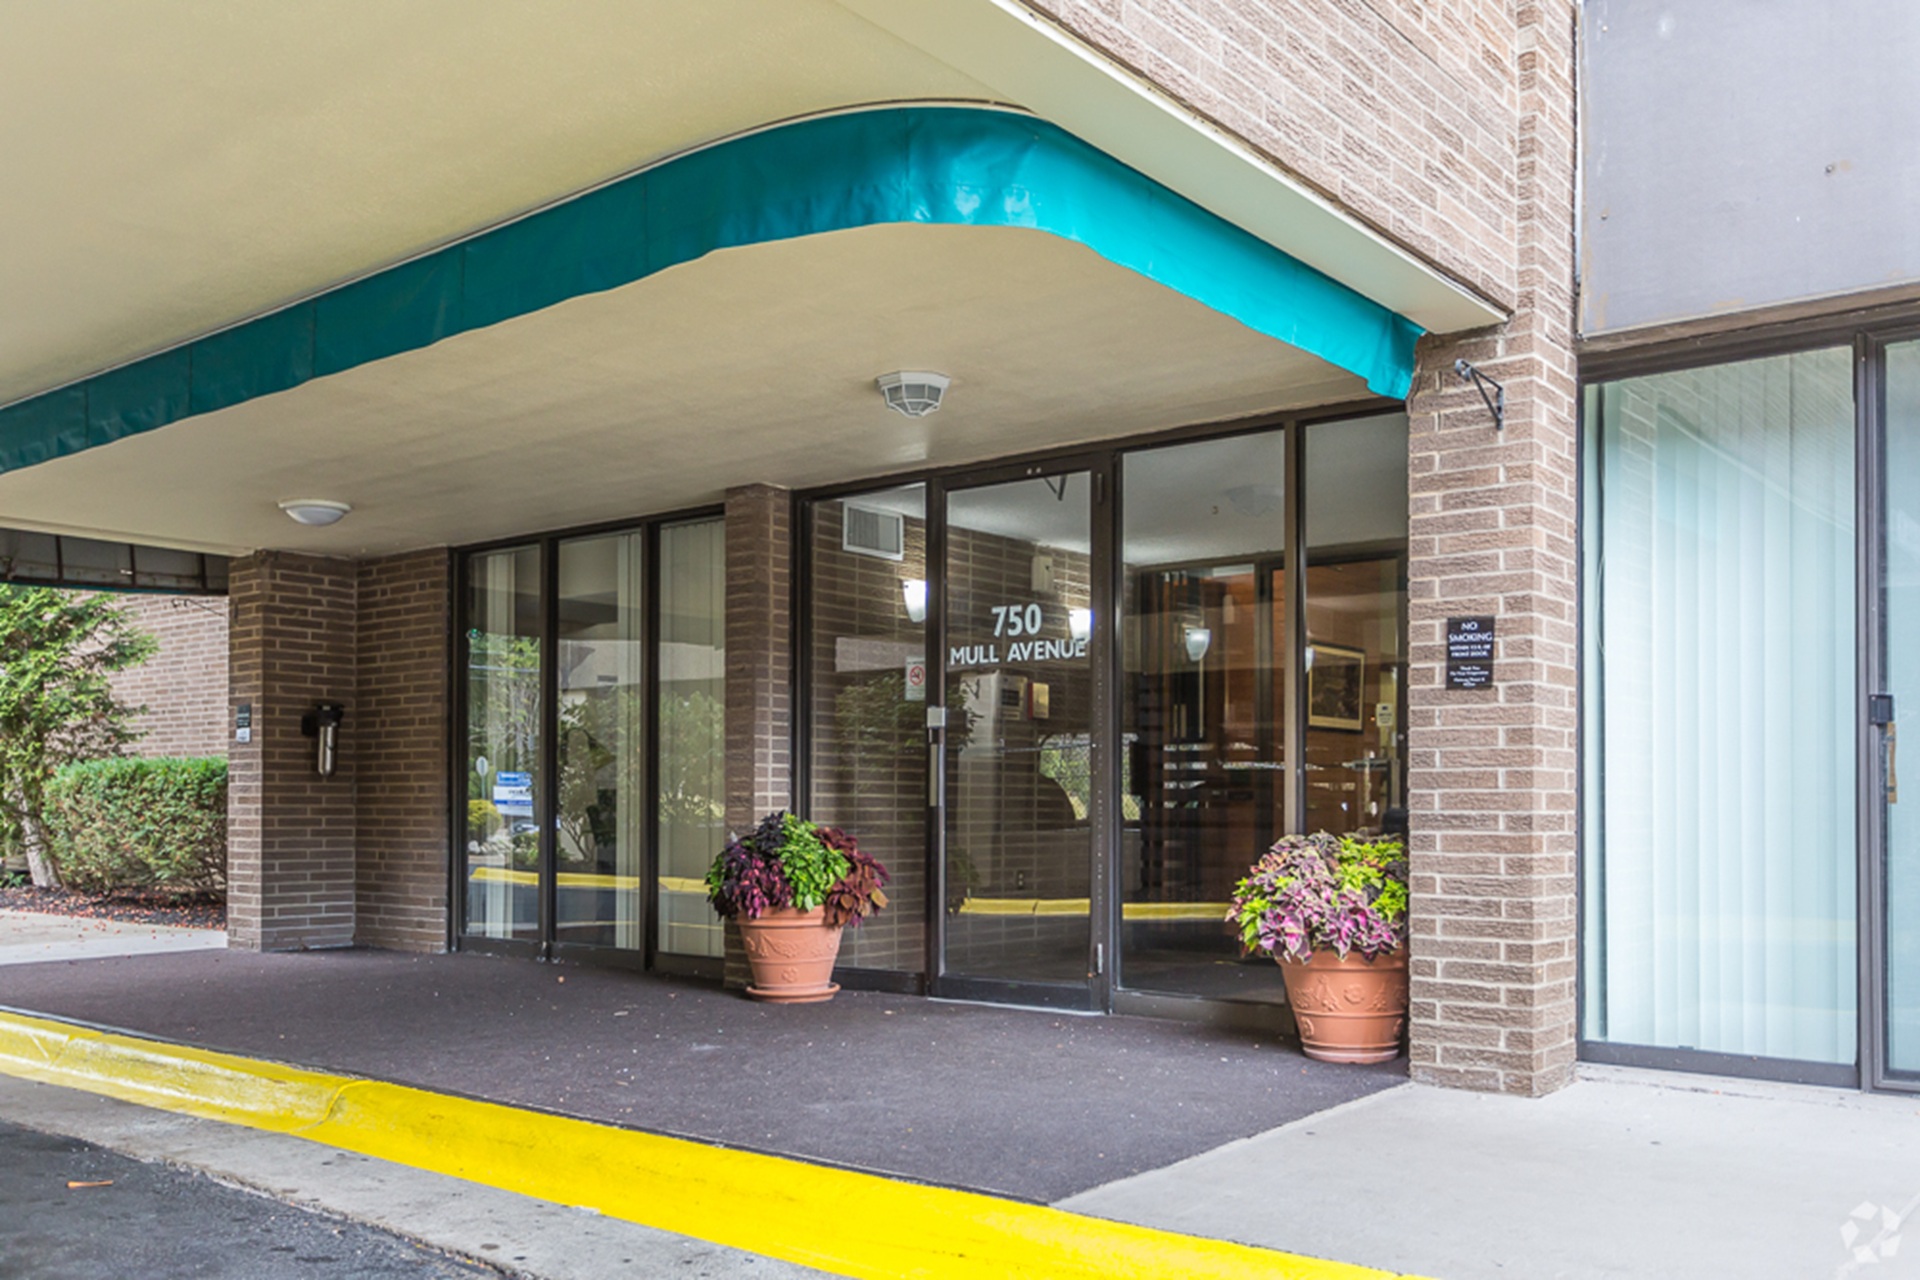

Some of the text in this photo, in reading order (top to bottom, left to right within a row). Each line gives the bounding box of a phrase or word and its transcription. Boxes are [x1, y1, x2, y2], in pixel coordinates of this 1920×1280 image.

[991, 603, 1042, 637] 750
[1461, 621, 1478, 631] NO
[1448, 632, 1493, 643] SMOKING
[950, 638, 1086, 665] MULL AVENUE
